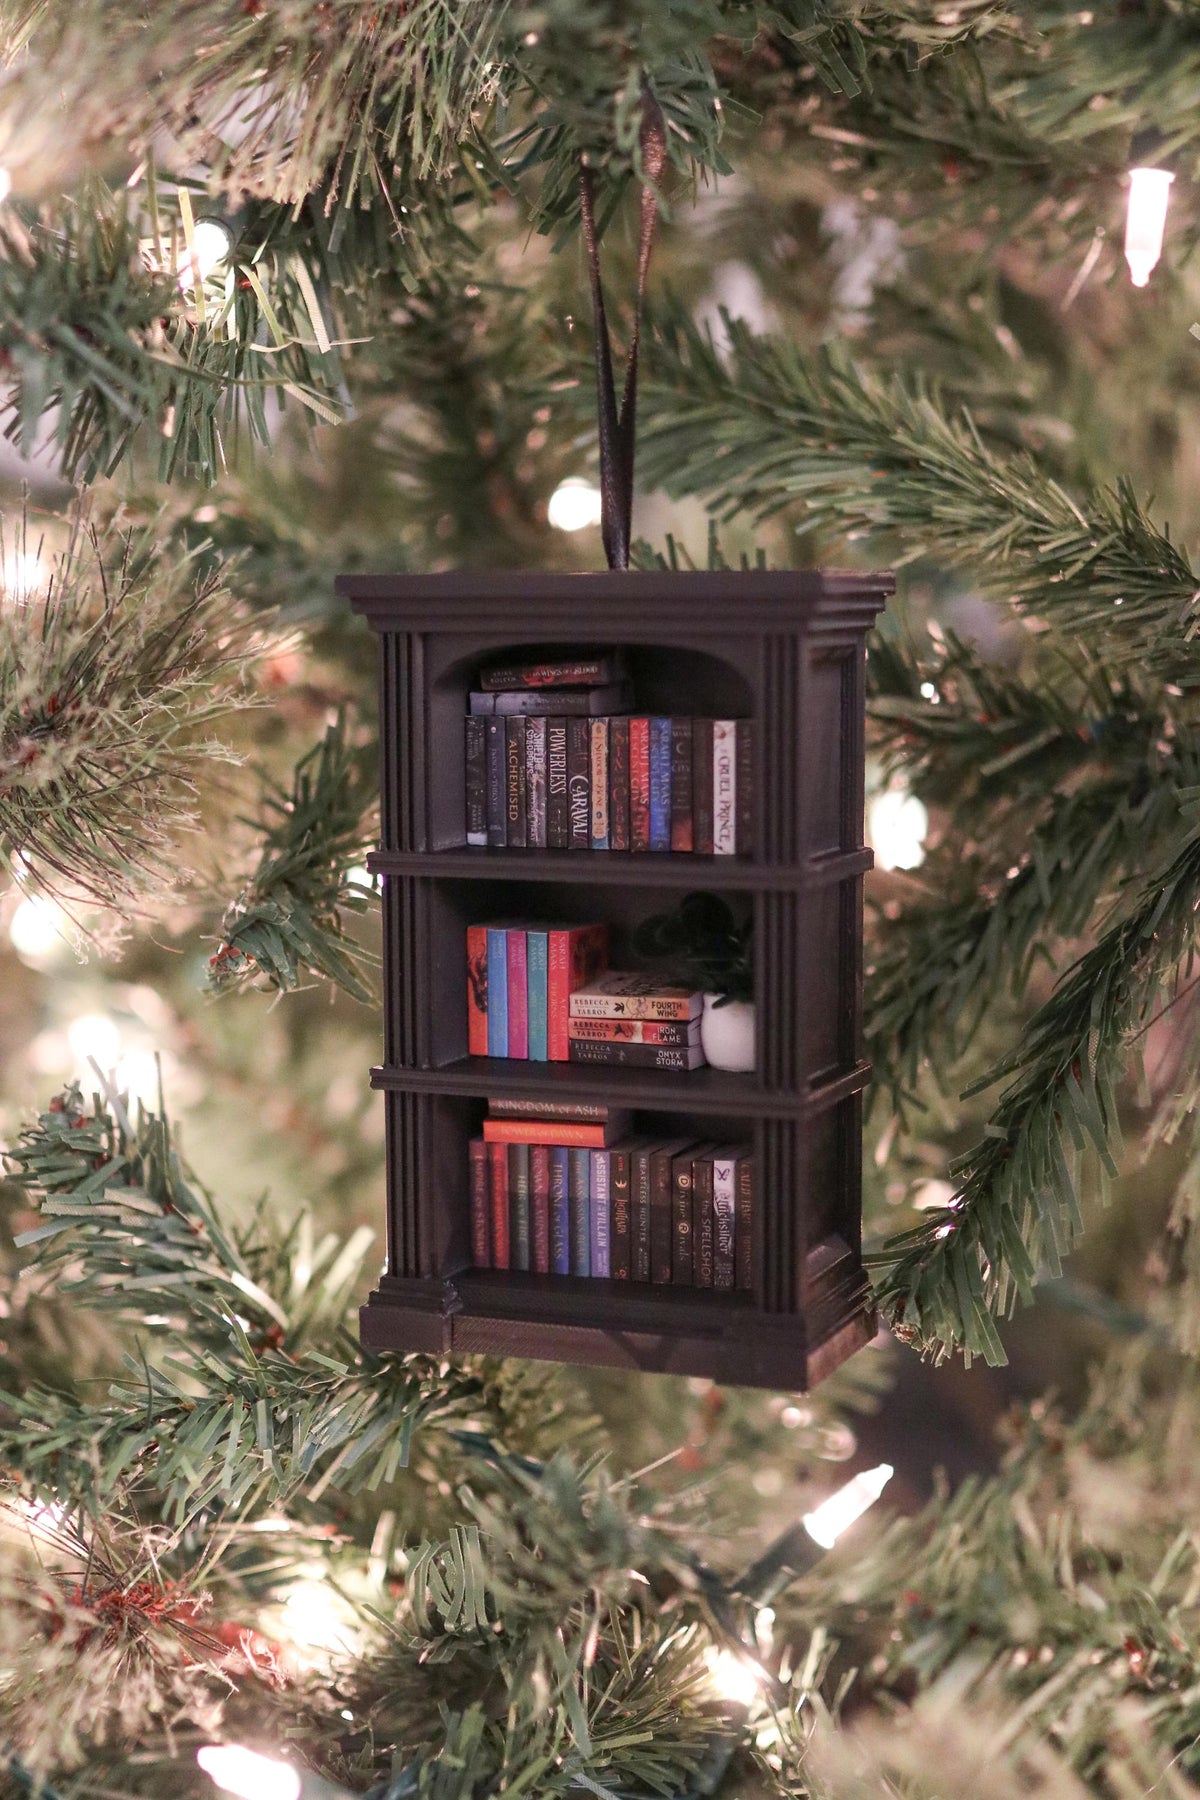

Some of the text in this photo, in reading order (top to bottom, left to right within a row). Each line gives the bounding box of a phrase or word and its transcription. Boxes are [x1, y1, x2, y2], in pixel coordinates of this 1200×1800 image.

[534, 733, 544, 763] SHIELD
[640, 721, 649, 759] SARAH
[660, 721, 669, 759] SARAH
[549, 728, 566, 794] POWERLESS
[718, 755, 731, 795] CRUEL
[509, 739, 518, 821] ALCHEMISED
[640, 772, 649, 805] MAAS
[661, 773, 670, 805] MAAS
[569, 775, 589, 837] CARAVAL
[717, 800, 732, 842] PRINCE
[651, 1001, 682, 1009] FOURTH
[573, 1021, 610, 1029] REBECCA
[652, 1034, 681, 1043] FLAME
[575, 1043, 611, 1051] REBECCA
[578, 1052, 608, 1060] YARROS
[658, 1050, 680, 1058] ONYX
[497, 1100, 555, 1112] KINGDOM
[574, 1106, 599, 1116] ASH
[518, 1175, 526, 1200] HEIR
[534, 1150, 544, 1193] CROWN
[553, 1163, 564, 1206] THRONE
[597, 1159, 606, 1205] ASSISTANT
[639, 1157, 648, 1204] HEARTLESS
[640, 1207, 648, 1242] HUNTER
[701, 1200, 712, 1216] the
[715, 1190, 731, 1255] Quicksilver
[519, 1219, 527, 1243] FIRE
[553, 1225, 564, 1260] GLASS
[597, 1211, 606, 1247] VILLAIN
[677, 1222, 690, 1261] Rivals
[701, 1217, 712, 1285] SPELLSHOP
